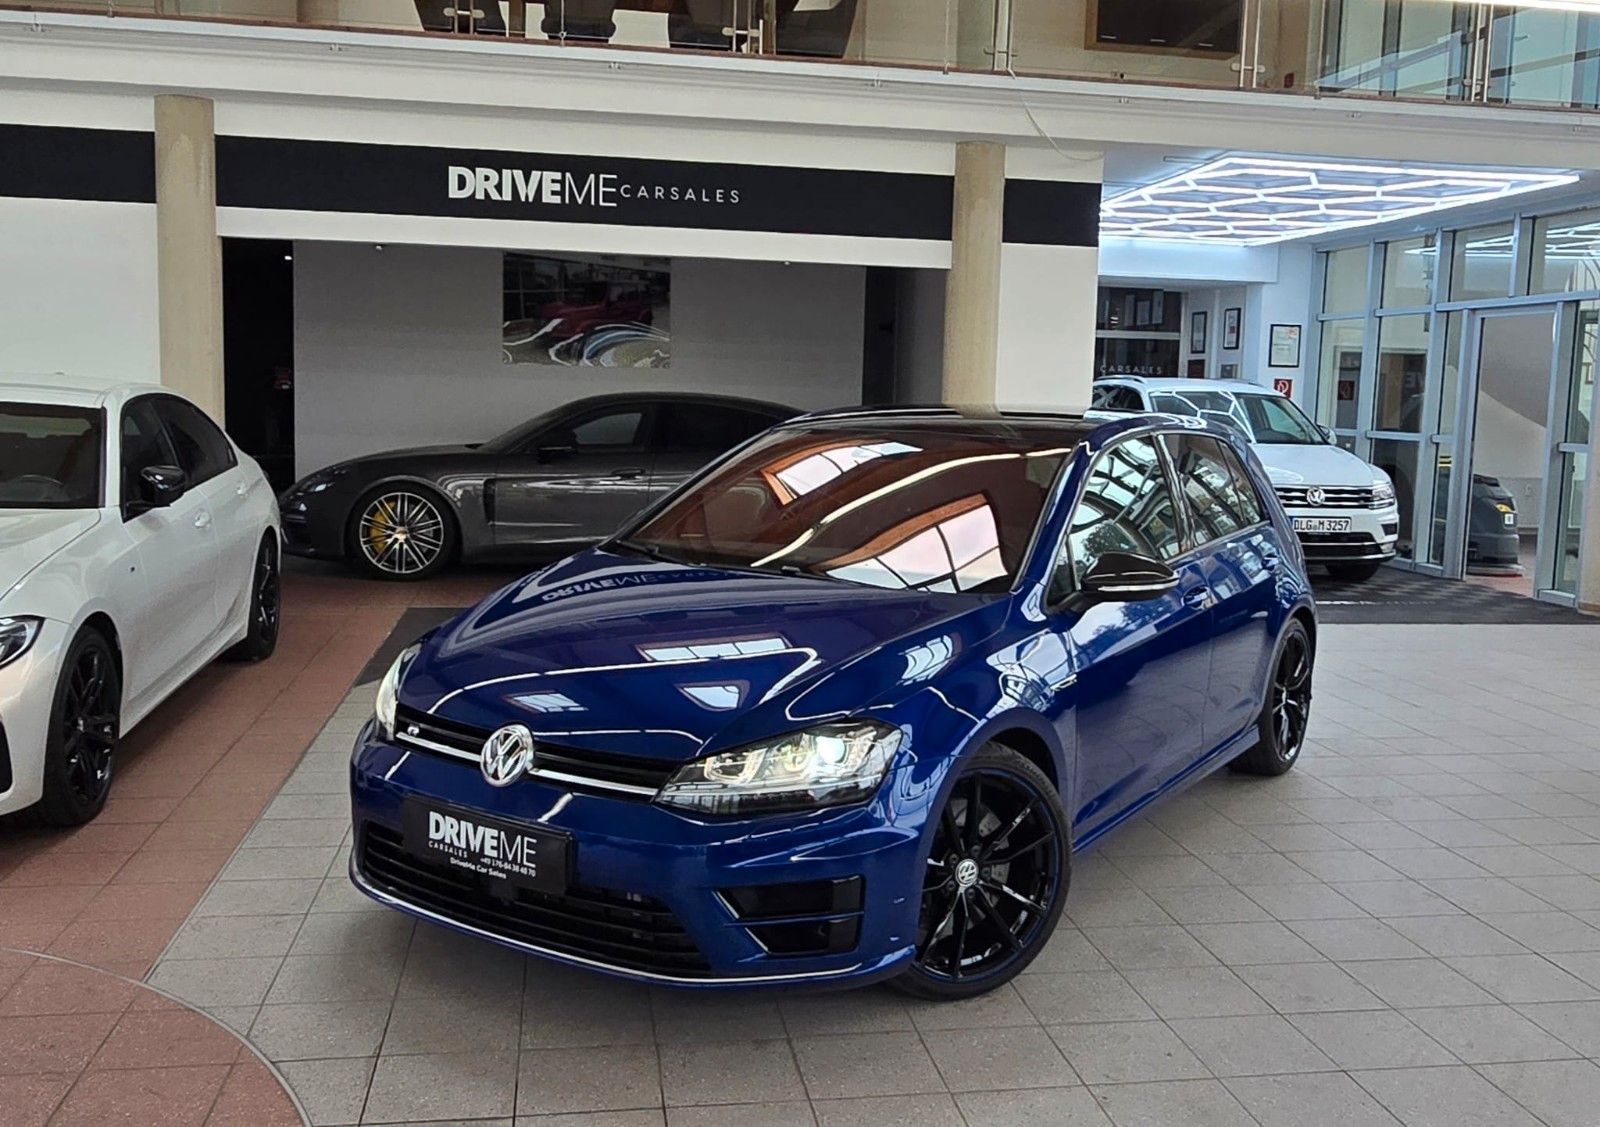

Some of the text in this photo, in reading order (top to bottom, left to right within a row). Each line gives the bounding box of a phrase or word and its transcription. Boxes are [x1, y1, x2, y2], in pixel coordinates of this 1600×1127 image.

[448, 165, 741, 207] DRIVEME CARSALES
[1326, 520, 1349, 531] 3257
[428, 810, 538, 868] DRIVEME
[428, 840, 468, 858] CARSALES
[476, 865, 487, 873] Car
[488, 868, 506, 879] Sales
